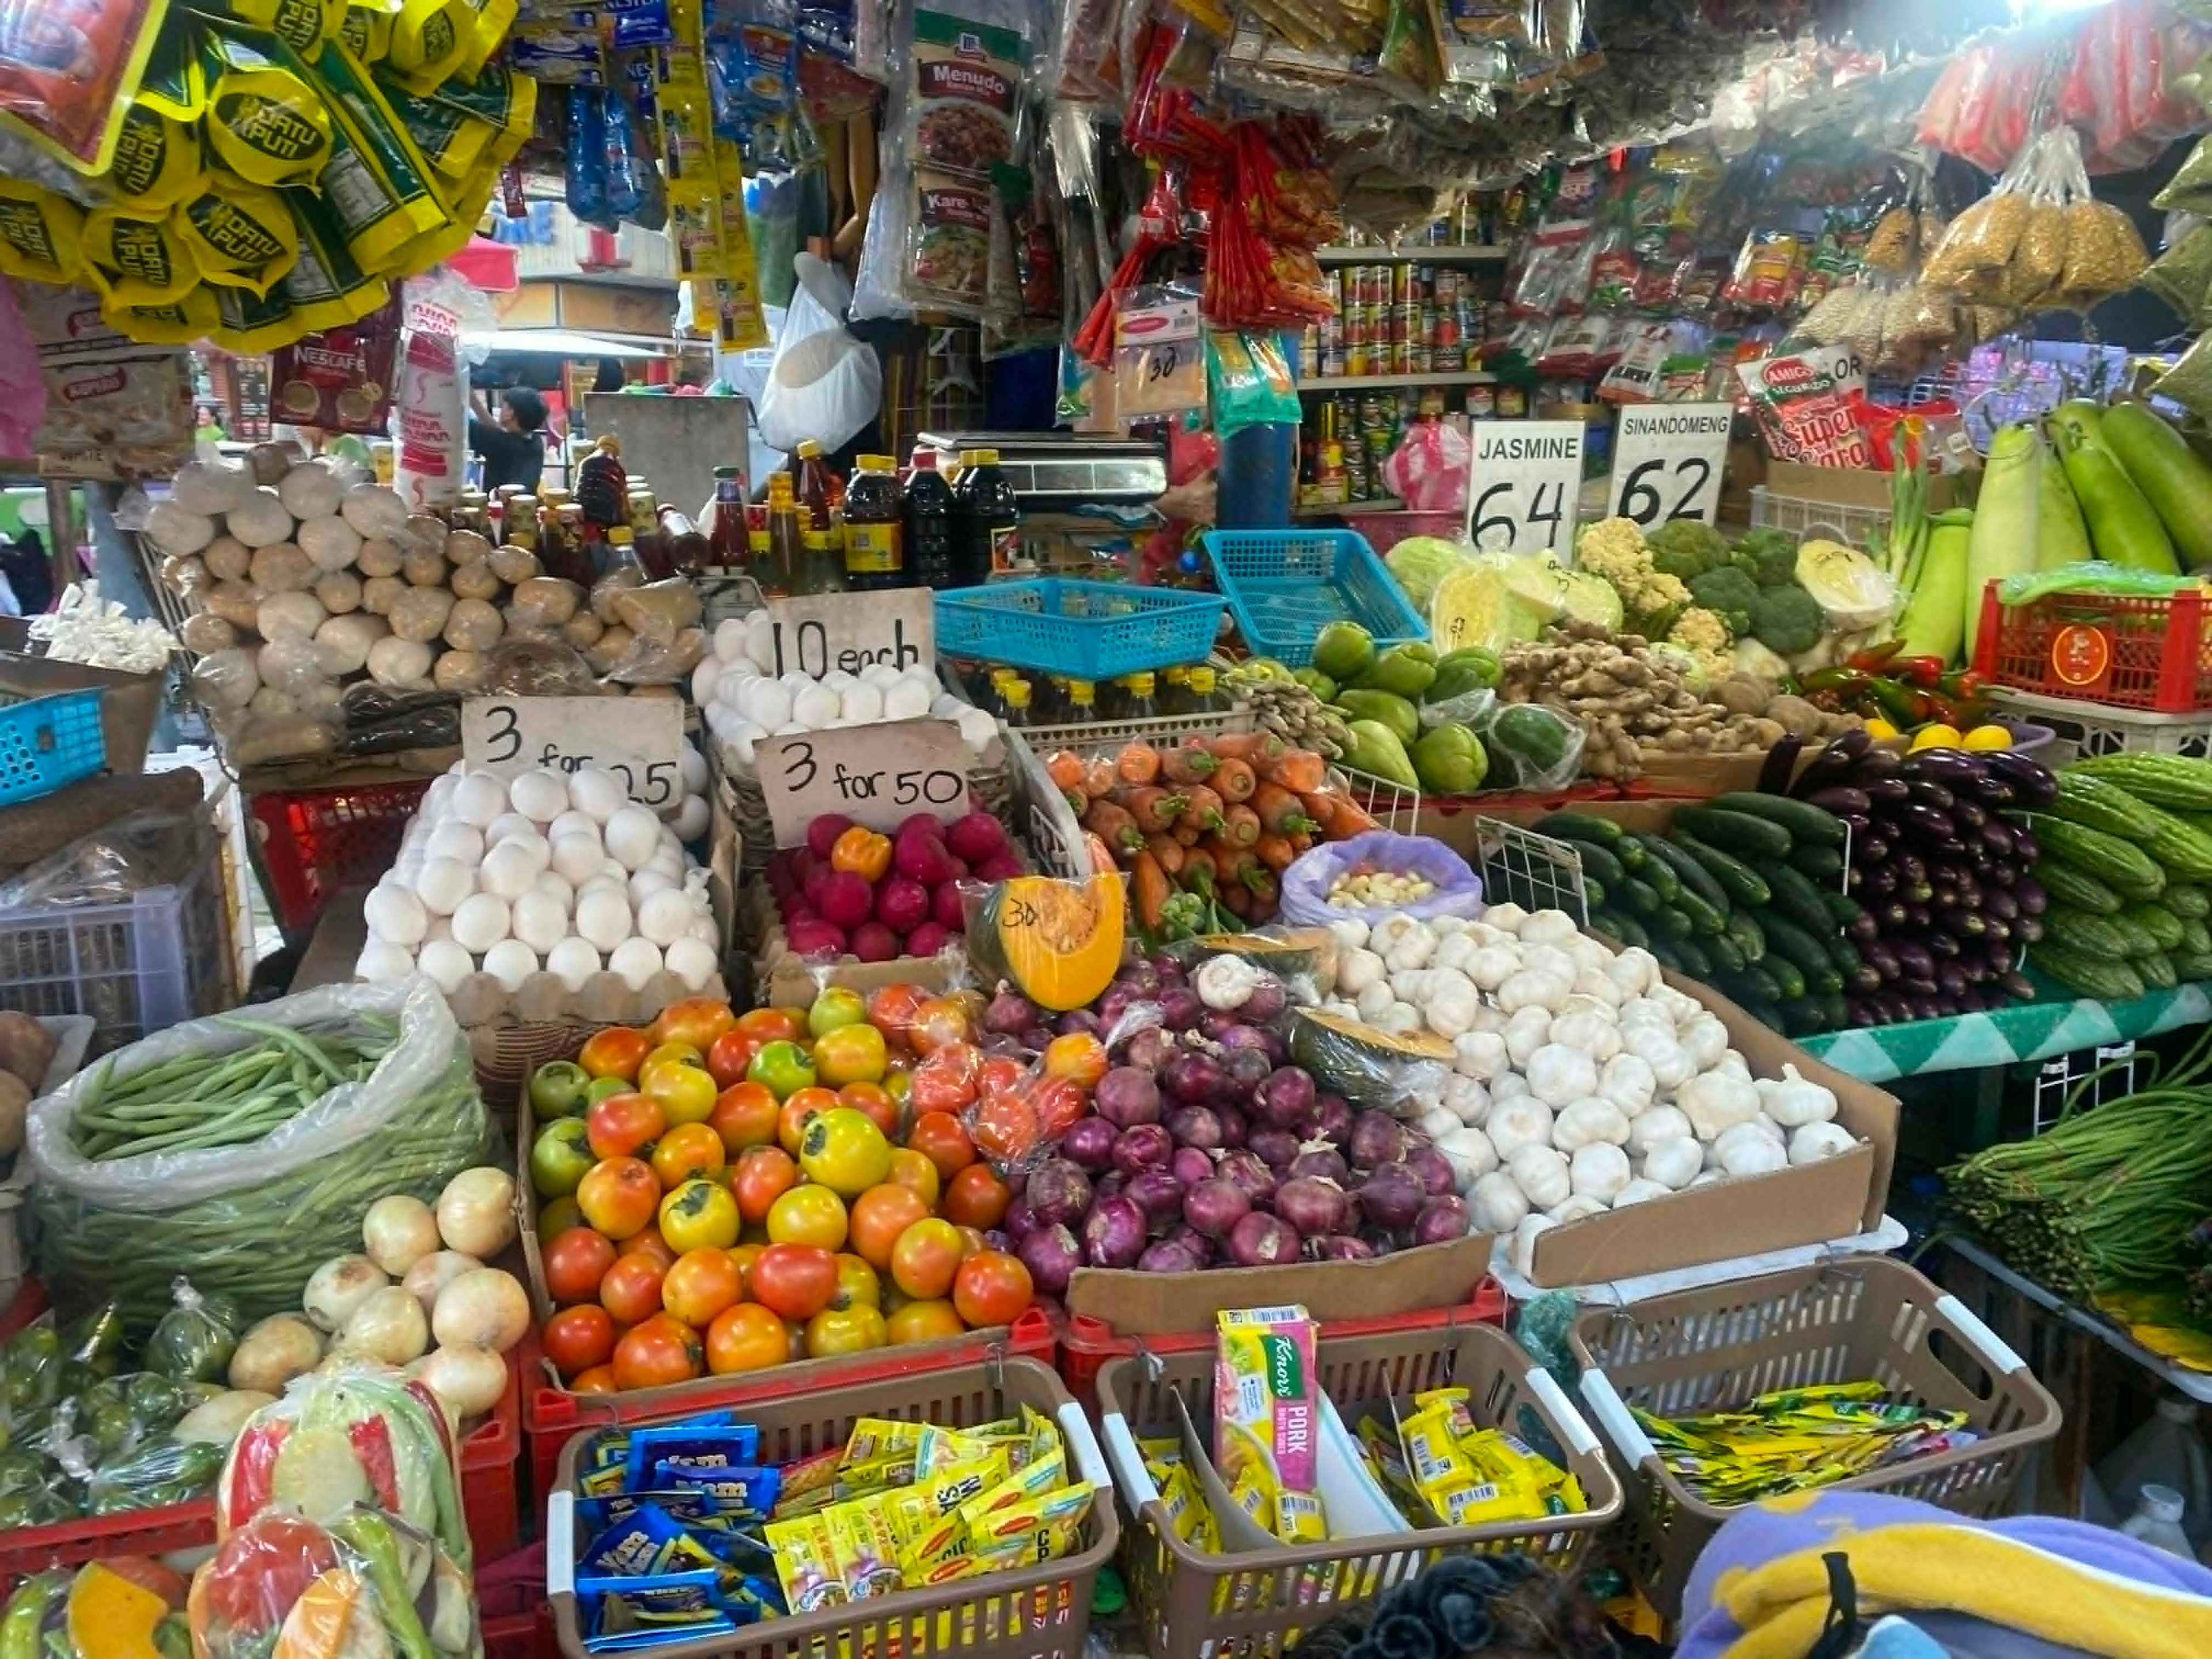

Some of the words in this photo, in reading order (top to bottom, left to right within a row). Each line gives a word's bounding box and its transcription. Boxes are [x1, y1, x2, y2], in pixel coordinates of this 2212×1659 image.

[933, 65, 1005, 94] Menudo
[250, 121, 300, 158] PUTI
[258, 105, 317, 146] DATU
[211, 228, 259, 260] PUTI
[227, 215, 282, 255] DATU
[1835, 357, 1862, 380] OR
[1624, 416, 1728, 435] SINANDOMENG
[1780, 406, 1858, 459] Super
[1479, 438, 1578, 459] JASMINE
[1617, 457, 1710, 525] 62
[1471, 482, 1565, 552] 64
[772, 621, 828, 682] 10
[487, 706, 522, 763] 3
[538, 743, 593, 774] for
[781, 741, 817, 792] 3
[834, 763, 886, 799] for
[894, 770, 963, 805] 50
[1275, 1336, 1293, 1397] Knorr
[1287, 1407, 1308, 1453] PORK
